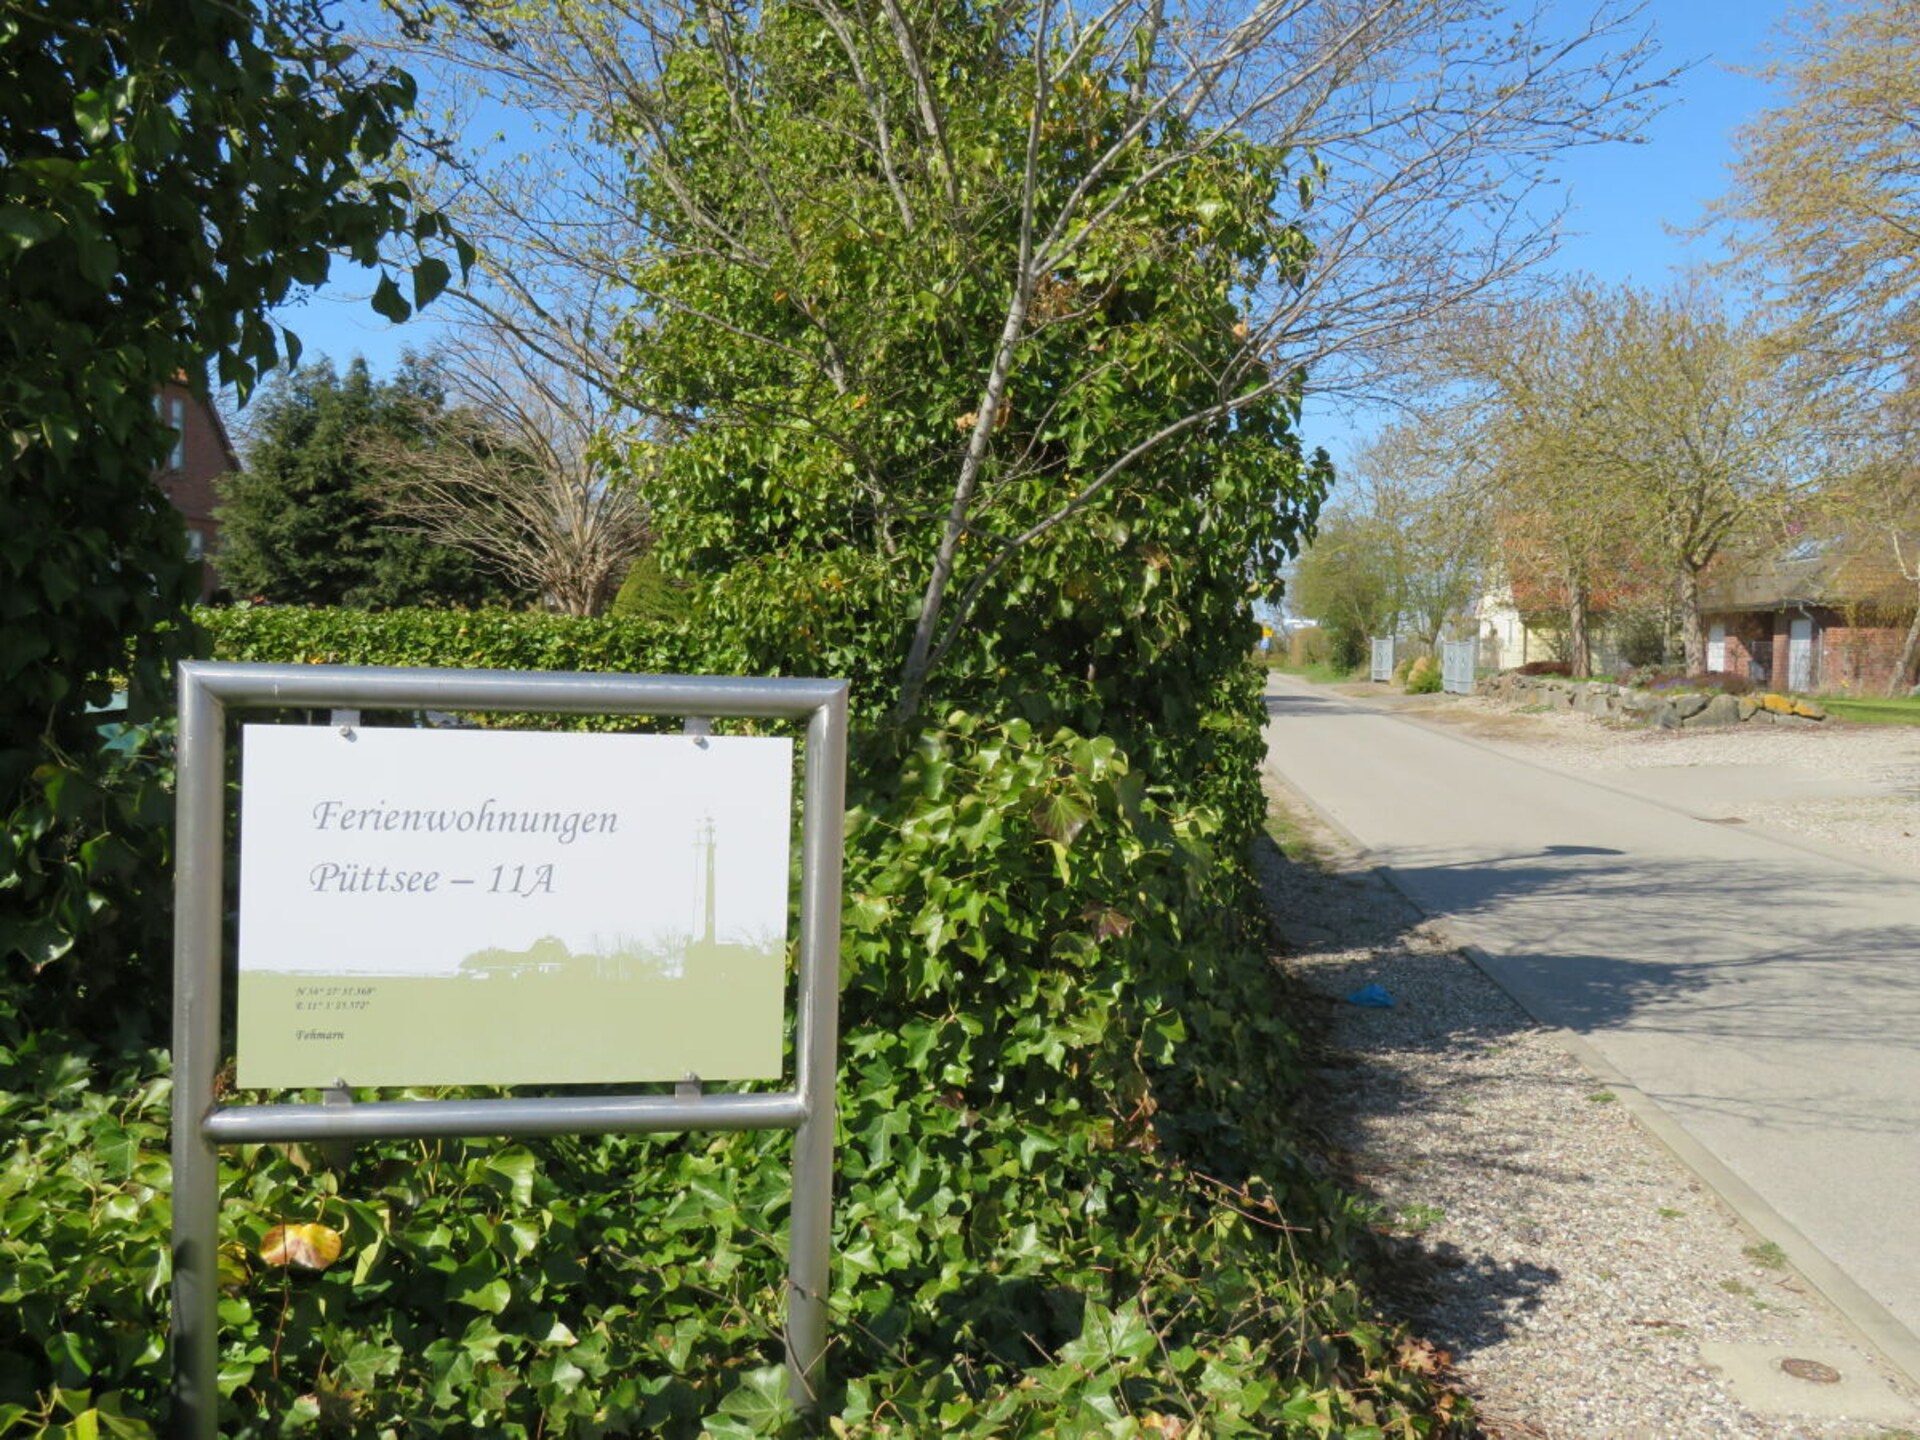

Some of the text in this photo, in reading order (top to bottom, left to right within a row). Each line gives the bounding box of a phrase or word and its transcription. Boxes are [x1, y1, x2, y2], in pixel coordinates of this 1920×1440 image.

[311, 797, 619, 845] Ferienwohnungen
[308, 861, 441, 893] Püttsee
[487, 862, 556, 898] 11A
[295, 1027, 345, 1041] Fehmarn
